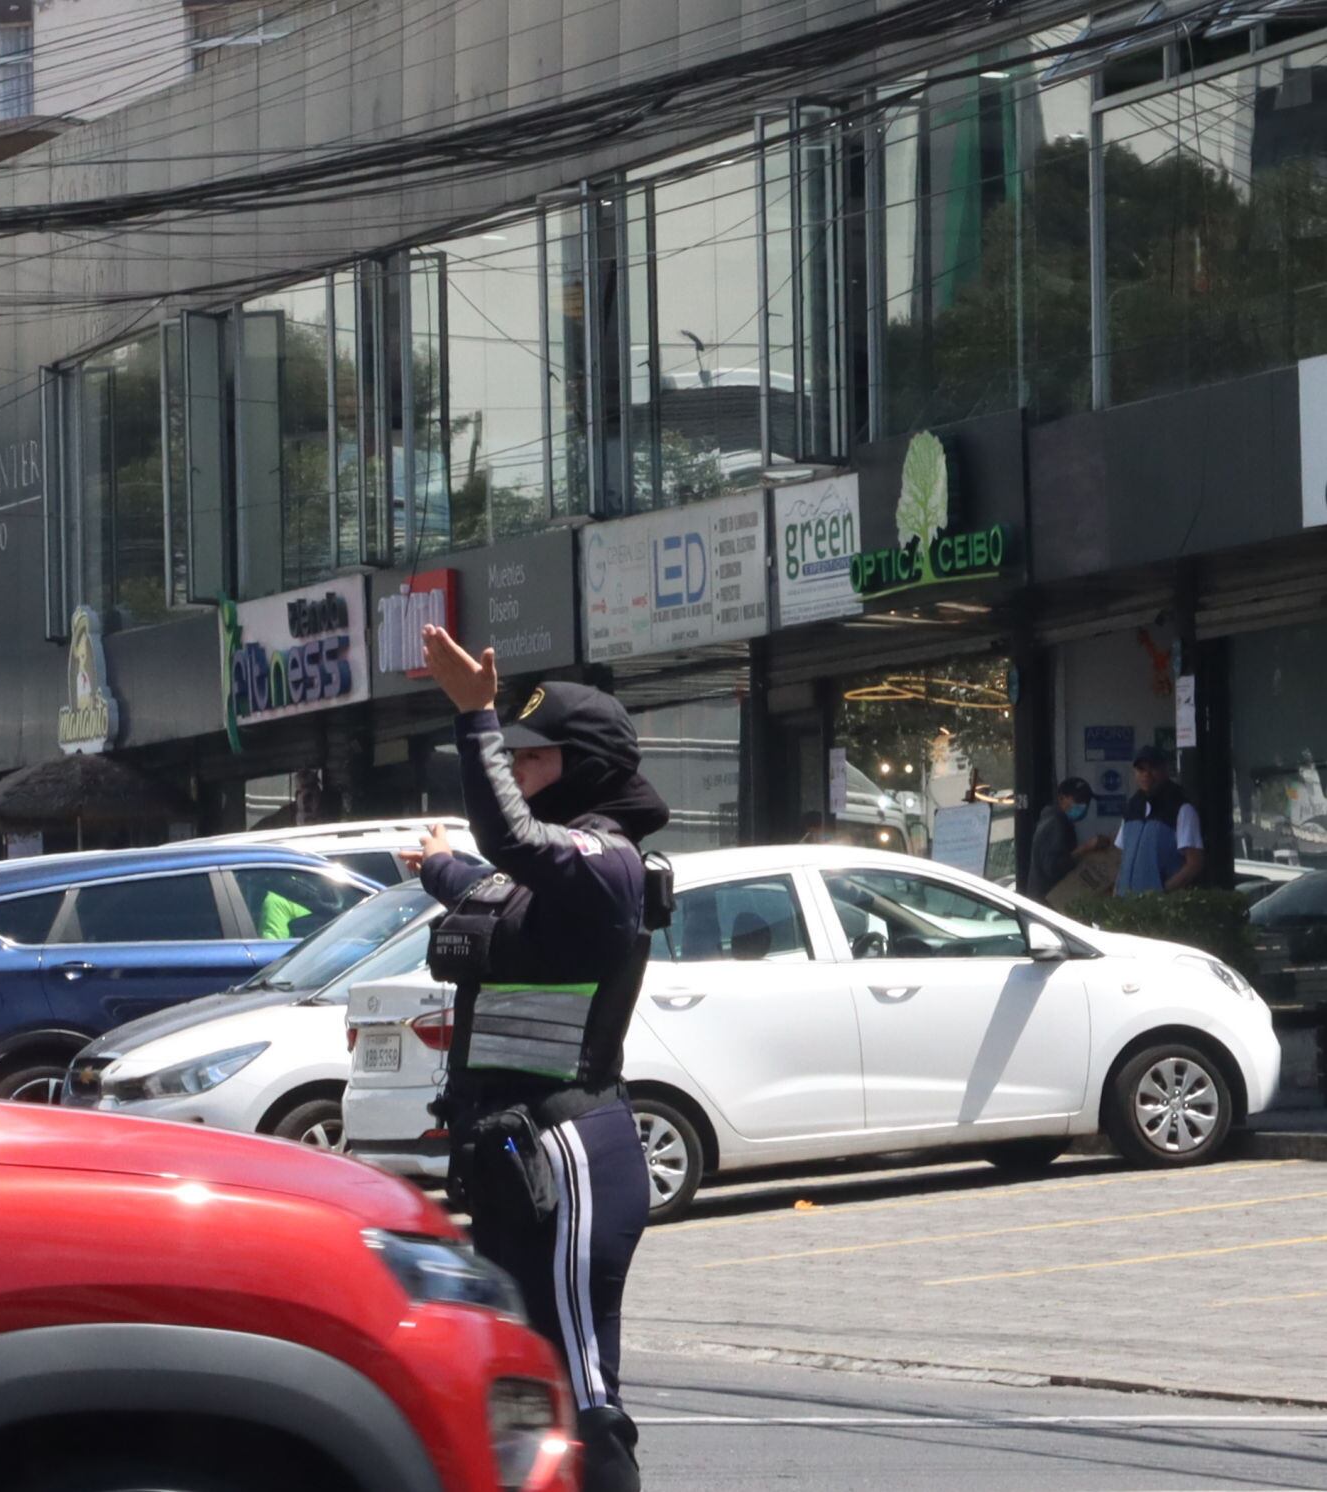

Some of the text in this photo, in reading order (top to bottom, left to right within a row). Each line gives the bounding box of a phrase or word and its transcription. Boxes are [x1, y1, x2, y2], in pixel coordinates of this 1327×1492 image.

[488, 563, 526, 588] Muebles
[653, 532, 707, 608] LED
[785, 512, 855, 580] green
[850, 524, 1003, 594] OPTICA CEIBO
[489, 596, 519, 623] Diseño
